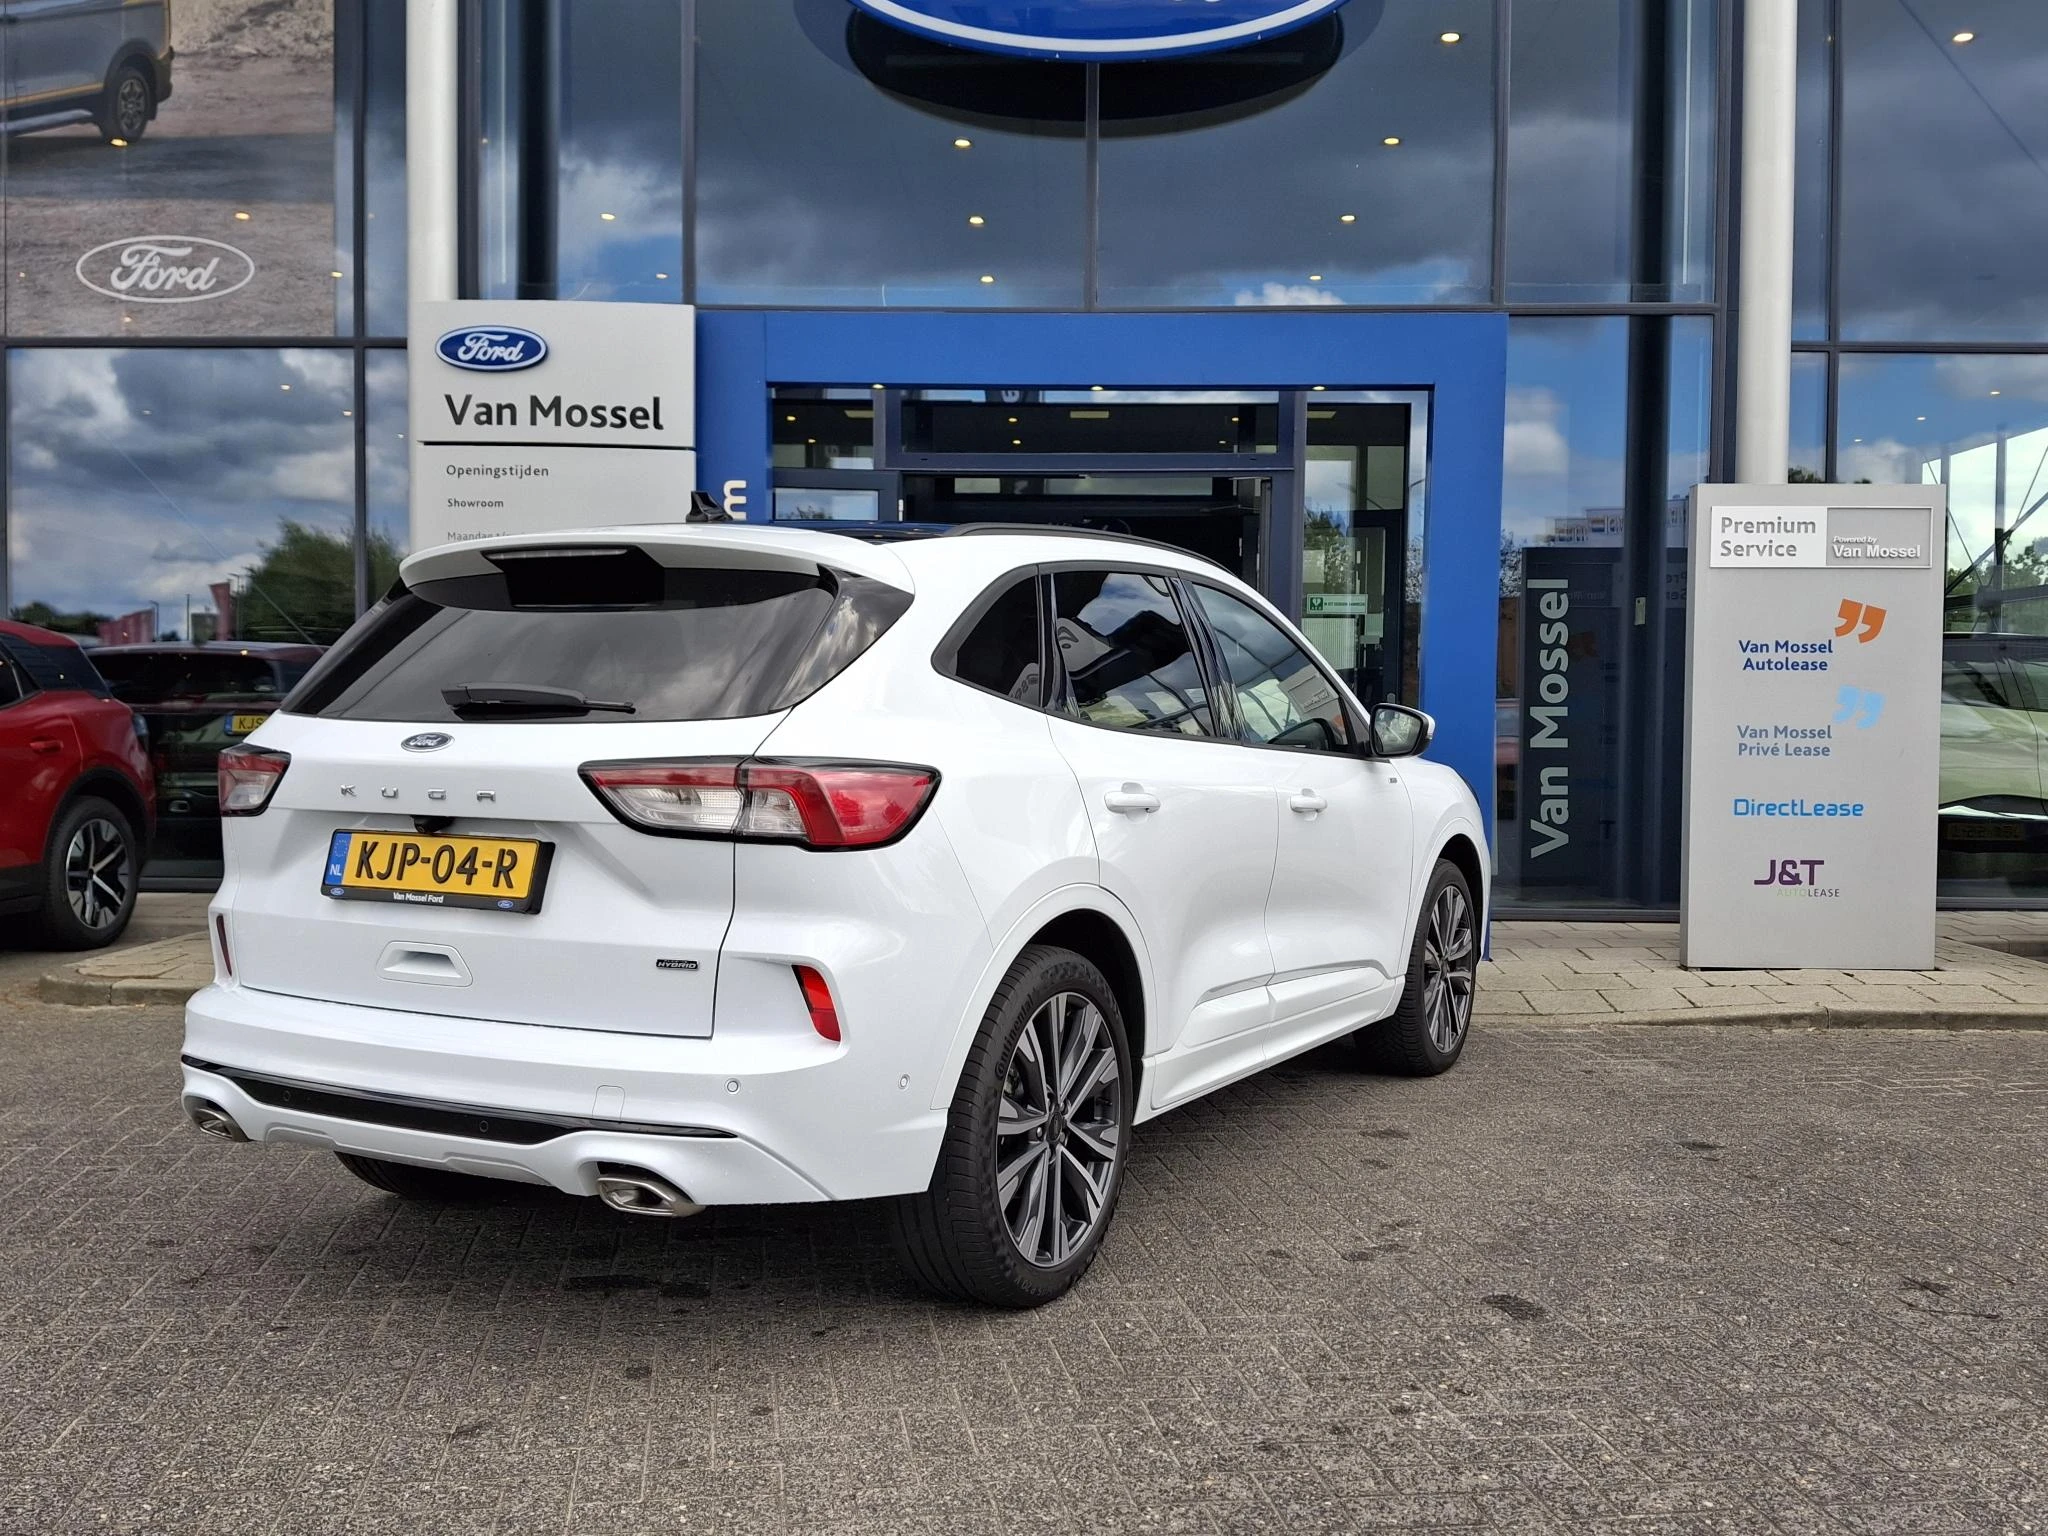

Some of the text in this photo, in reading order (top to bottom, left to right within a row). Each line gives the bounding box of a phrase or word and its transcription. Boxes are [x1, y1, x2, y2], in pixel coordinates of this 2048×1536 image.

[110, 244, 220, 291] Ford
[457, 332, 525, 362] Ford
[444, 394, 664, 430] Van Mossel
[446, 464, 549, 479] Openingstijden
[447, 498, 504, 508] Showroom
[1720, 516, 1816, 534] Premium
[1833, 535, 1877, 545] Powered by
[1720, 540, 1797, 557] Service
[1833, 544, 1921, 558] Van Mossel
[1738, 639, 1833, 654] Van Mossel
[1743, 657, 1828, 671] Autolease
[1527, 578, 1569, 859] Van Mossel
[1737, 725, 1832, 739] Van Mossel
[410, 734, 442, 747] Ford
[1738, 742, 1830, 757] Privé Lease
[341, 784, 496, 802] KUGA
[1734, 798, 1864, 817] DirectLease
[330, 864, 342, 877] NL
[355, 841, 518, 889] KJP-04-R
[1754, 859, 1825, 886] J&T
[393, 892, 444, 904] Van Mossel Ford
[1777, 888, 1840, 898] AUTOLEASE
[657, 961, 697, 969] HYBRID
